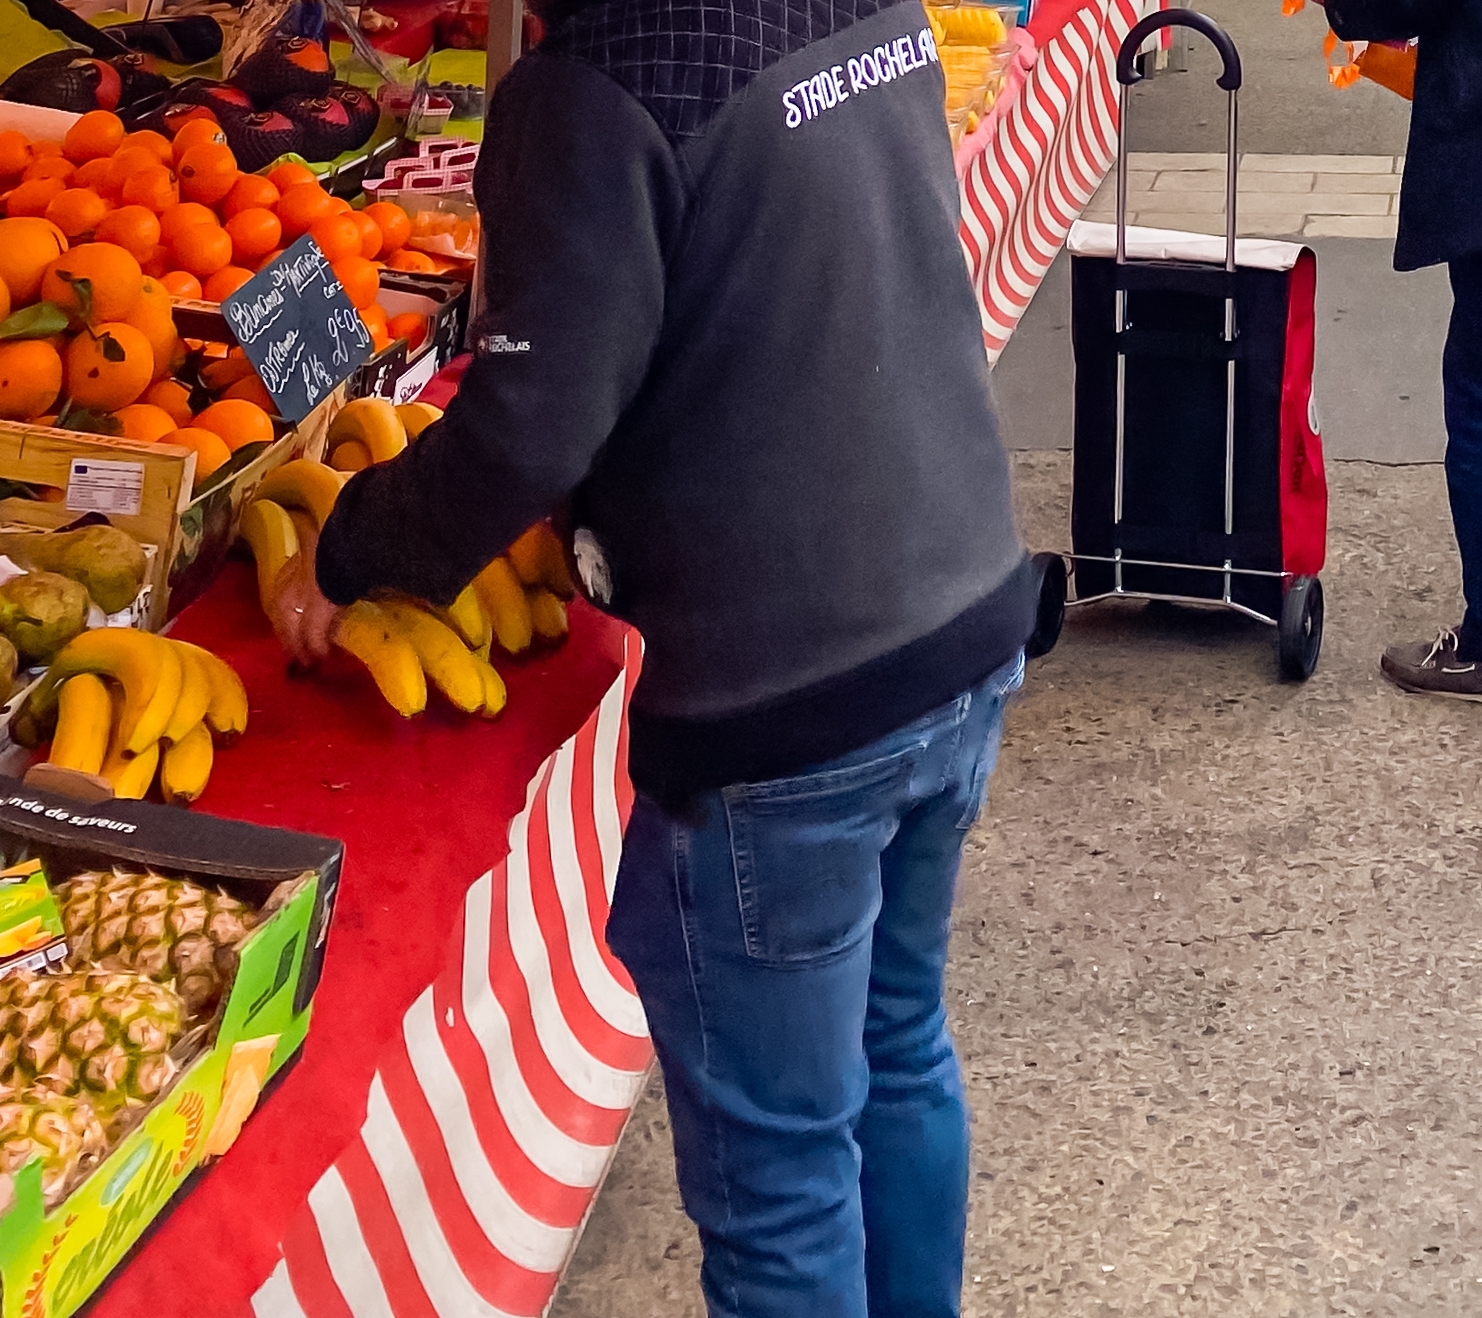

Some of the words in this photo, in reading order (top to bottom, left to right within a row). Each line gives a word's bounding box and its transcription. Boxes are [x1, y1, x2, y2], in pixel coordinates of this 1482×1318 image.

[782, 65, 849, 129] STADE
[44, 808, 69, 821] de
[68, 816, 138, 834] saveurs
